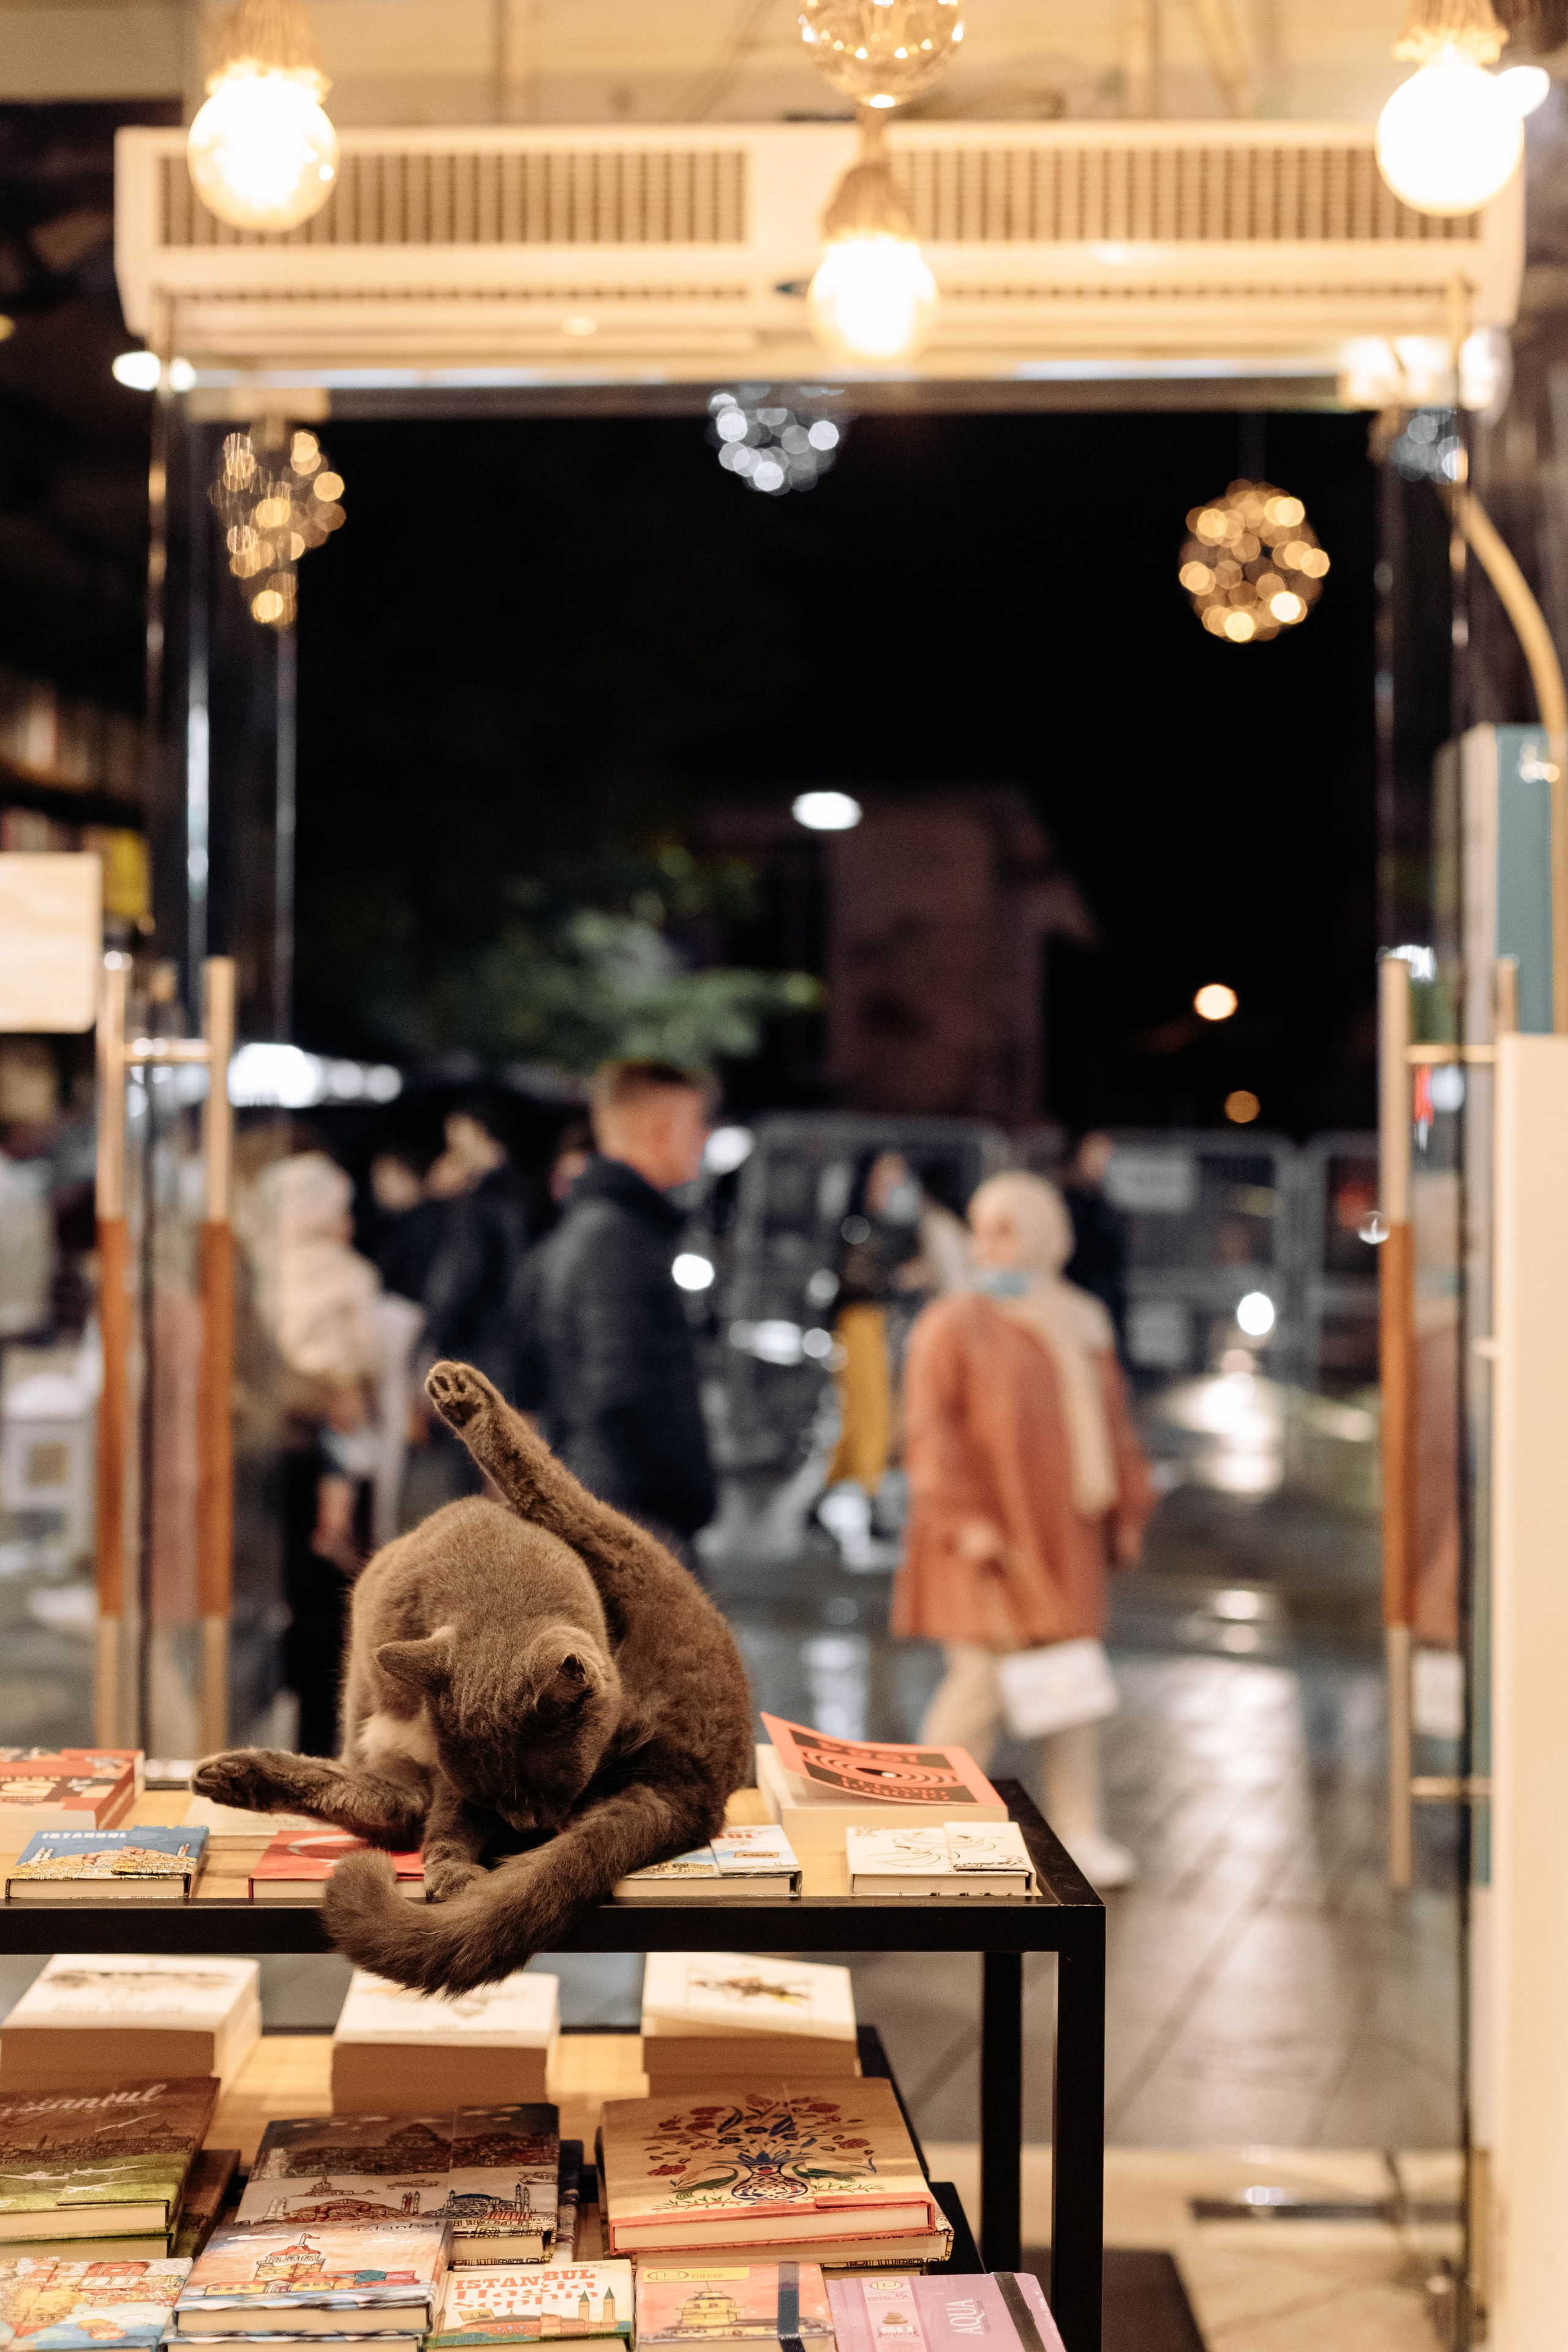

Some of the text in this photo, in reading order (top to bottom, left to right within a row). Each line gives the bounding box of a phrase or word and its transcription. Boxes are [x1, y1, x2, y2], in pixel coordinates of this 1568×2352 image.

[454, 2269, 595, 2290] ISTANBUL
[457, 2281, 595, 2299] Hagia
[946, 2299, 984, 2335] AQUA
